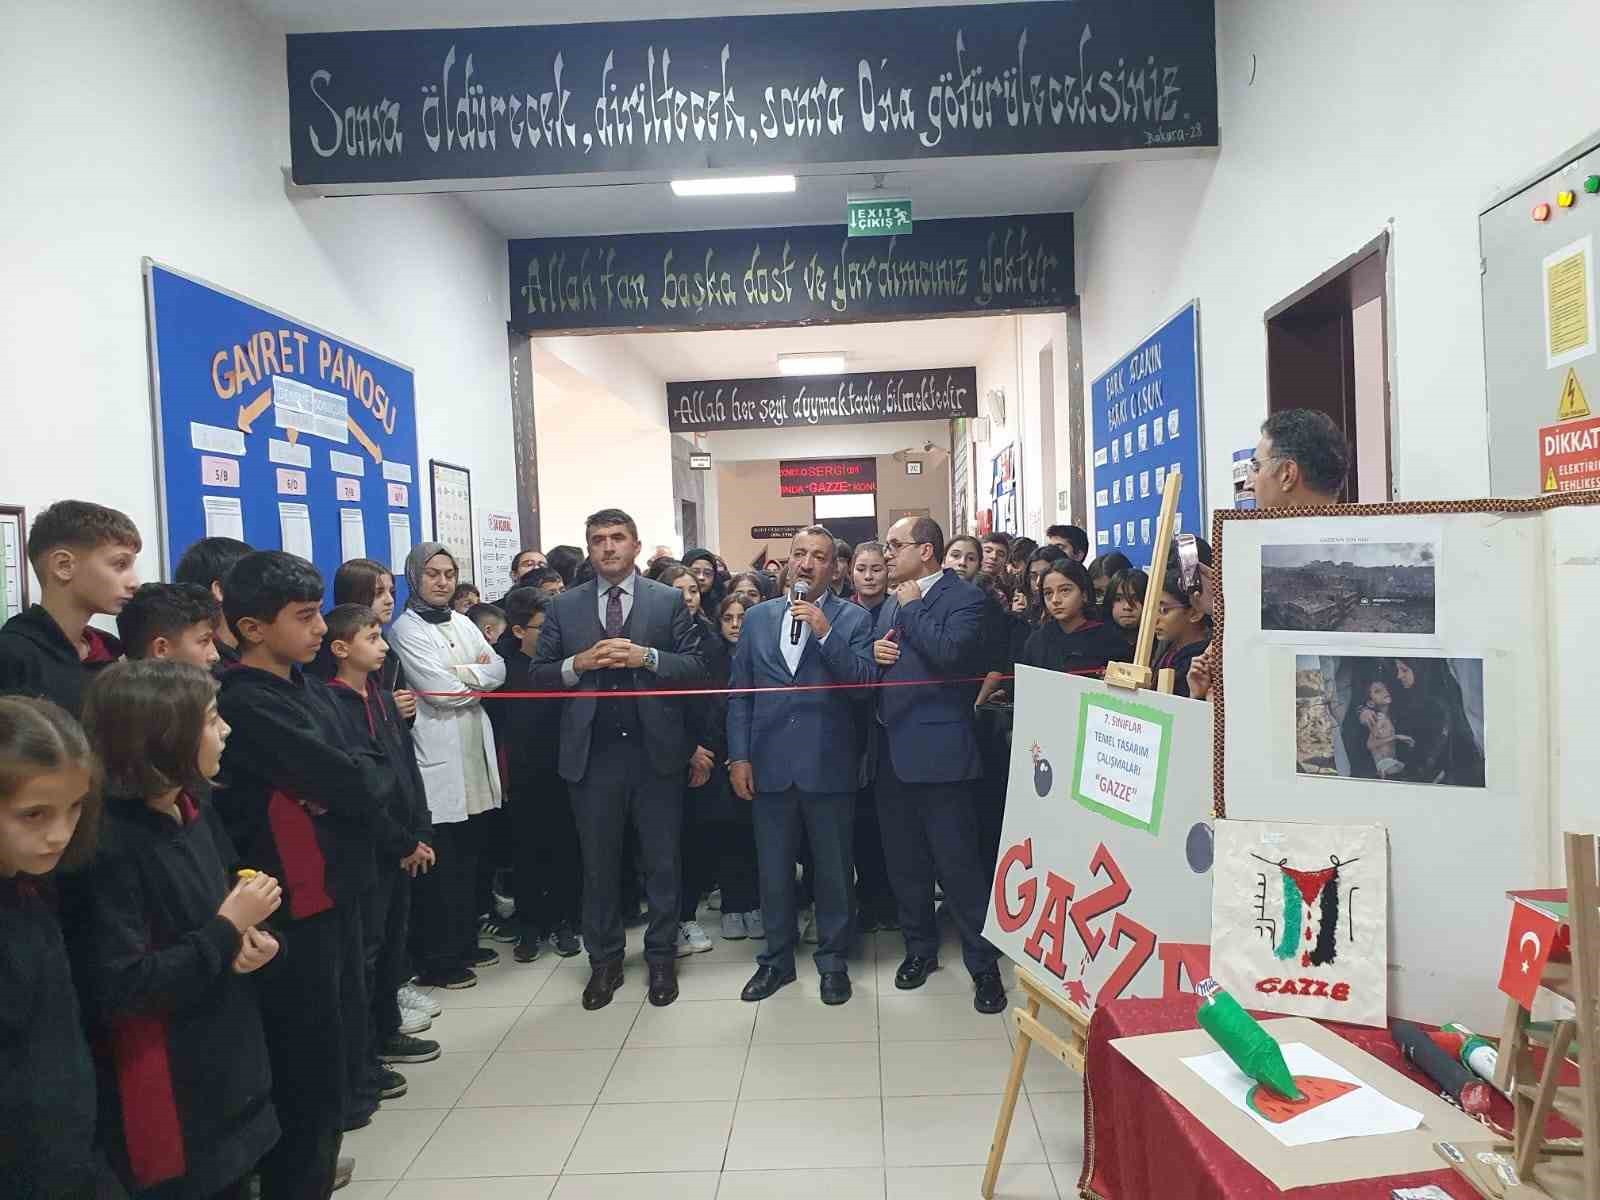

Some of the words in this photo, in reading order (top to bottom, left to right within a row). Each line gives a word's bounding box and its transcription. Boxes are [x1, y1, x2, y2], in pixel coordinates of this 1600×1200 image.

[310, 70, 402, 157] Sonra
[761, 76, 845, 138] sonra
[858, 58, 915, 133] O'na
[920, 24, 1191, 147] götürüleceksiniz.
[858, 207, 892, 218] EXIT
[858, 217, 893, 230] ÇIKIŞ
[661, 247, 736, 315] başka
[743, 240, 797, 305] dost
[804, 252, 827, 301] ve
[211, 328, 309, 400] GAYRET
[318, 339, 397, 435] PANOSU
[674, 387, 725, 424] Allah
[731, 387, 756, 420] her
[760, 394, 789, 426] şeyi
[1544, 427, 1600, 457] DİKKAT
[1111, 715, 1142, 735] SINIFLAR
[1094, 730, 1115, 748] TEMEL
[1117, 738, 1150, 761] TASARIM
[1095, 773, 1137, 802] "GAZZE"
